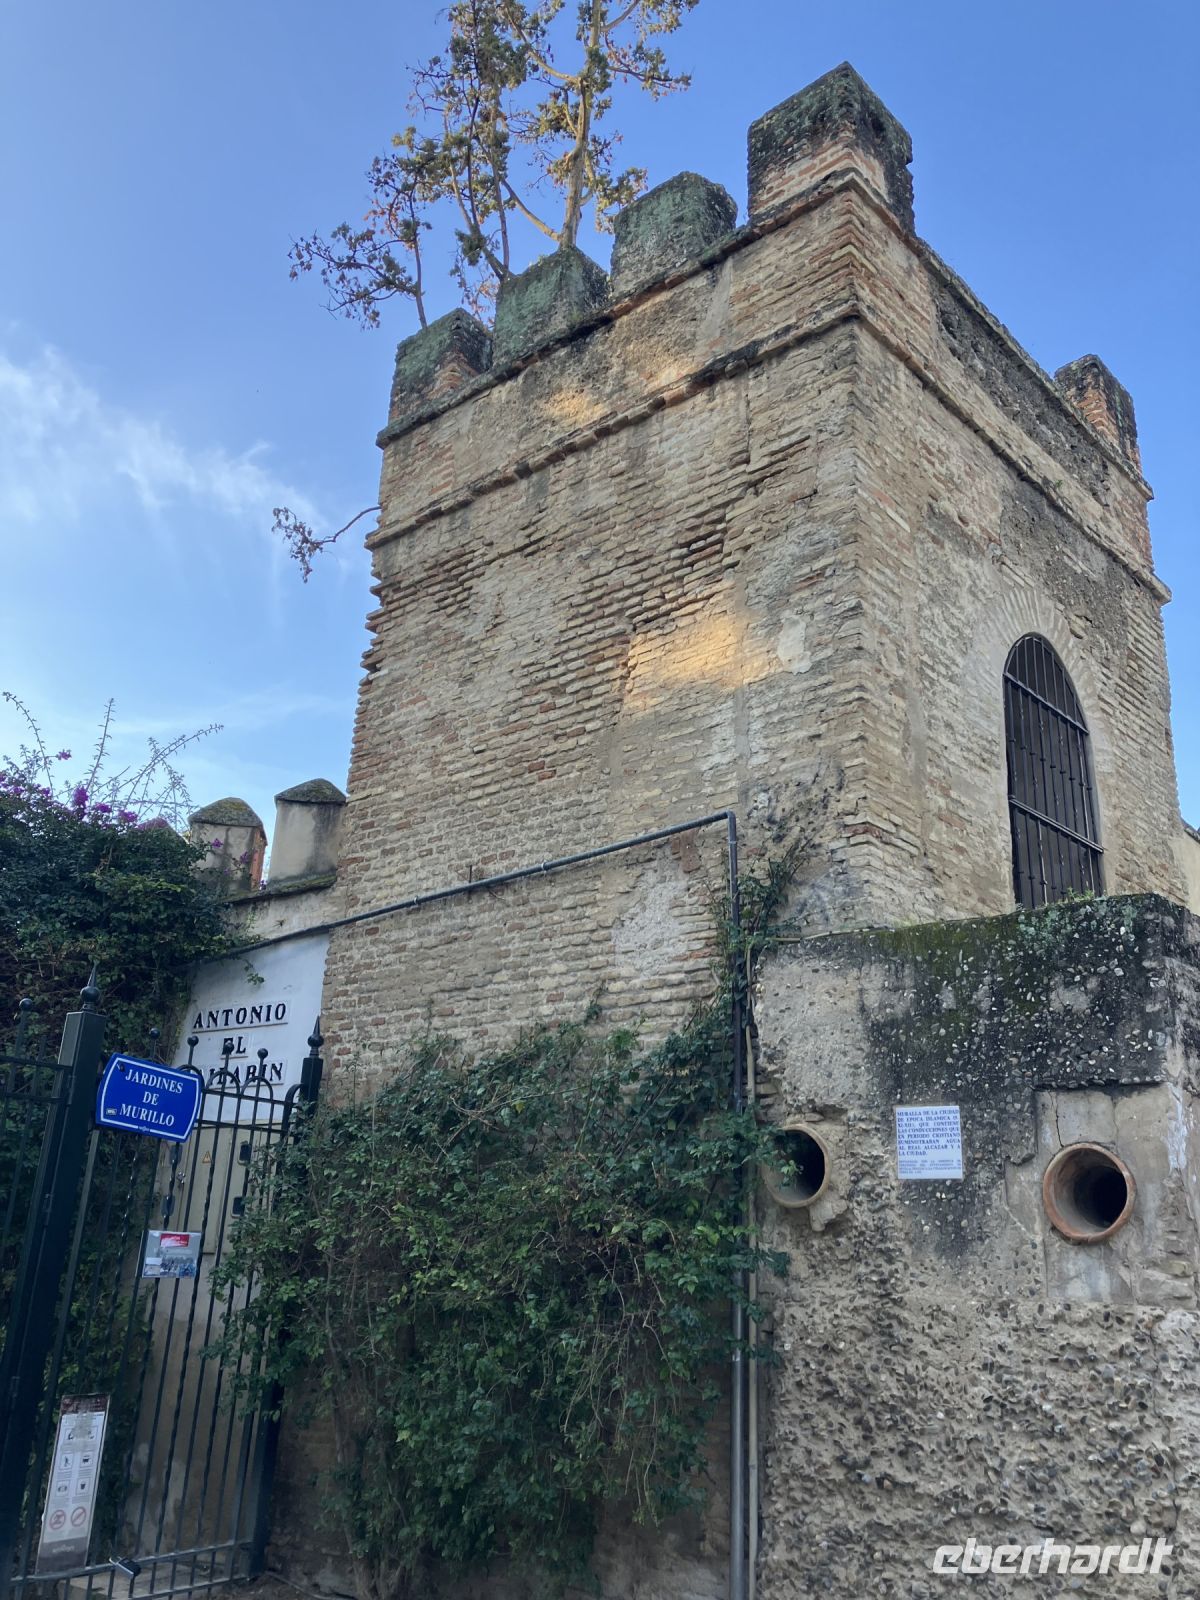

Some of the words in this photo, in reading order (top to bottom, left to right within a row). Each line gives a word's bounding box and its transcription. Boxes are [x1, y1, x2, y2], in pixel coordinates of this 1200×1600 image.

[193, 1003, 286, 1029] ANTONIO
[222, 1036, 246, 1055] EL
[125, 1069, 184, 1094] JARDINES
[142, 1091, 159, 1106] DE
[119, 1103, 175, 1127] MURILLO
